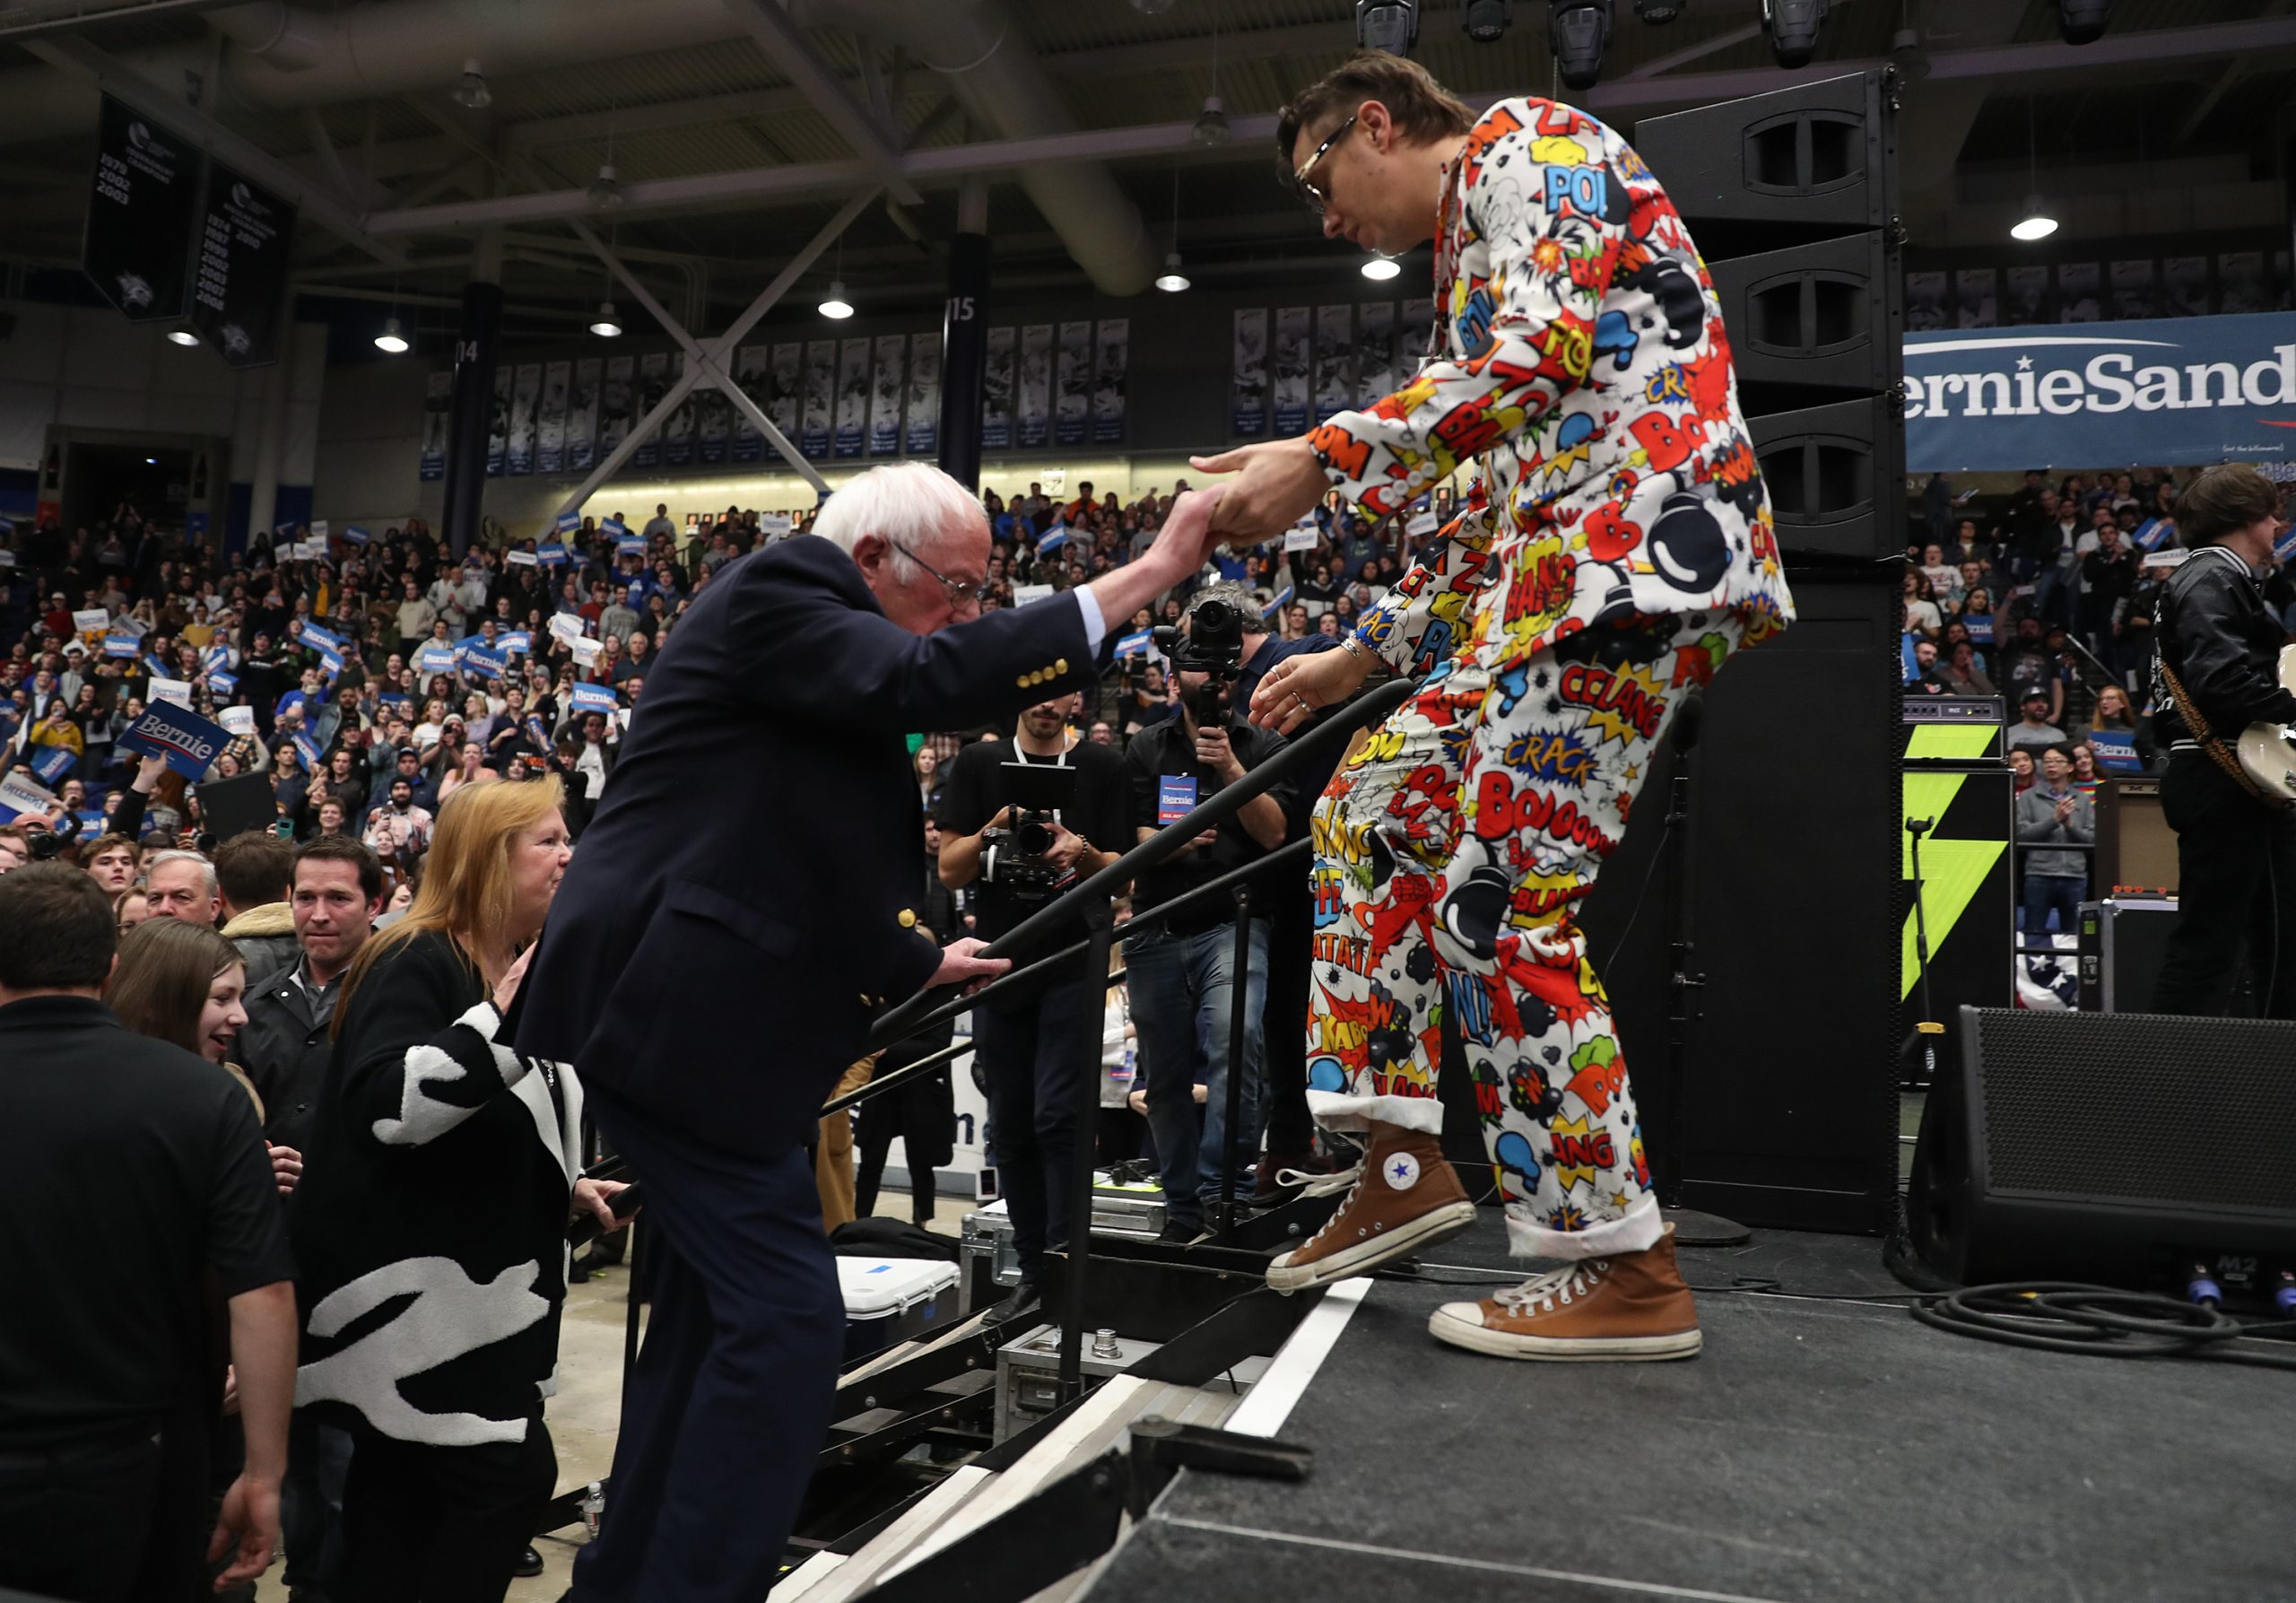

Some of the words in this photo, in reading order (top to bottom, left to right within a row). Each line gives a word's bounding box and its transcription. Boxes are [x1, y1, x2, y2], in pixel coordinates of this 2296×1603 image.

[98, 167, 132, 191] 2002
[96, 180, 130, 205] 2003
[235, 229, 262, 251] 2010
[201, 250, 230, 273] 2002
[1903, 344, 2296, 420] ernieSand
[466, 649, 503, 670] Bernie
[152, 684, 187, 697] Bernie
[575, 689, 613, 702] Bernie
[137, 713, 213, 761] Bernie
[1503, 736, 1599, 789] CRACK
[1162, 795, 1194, 806] Bernie
